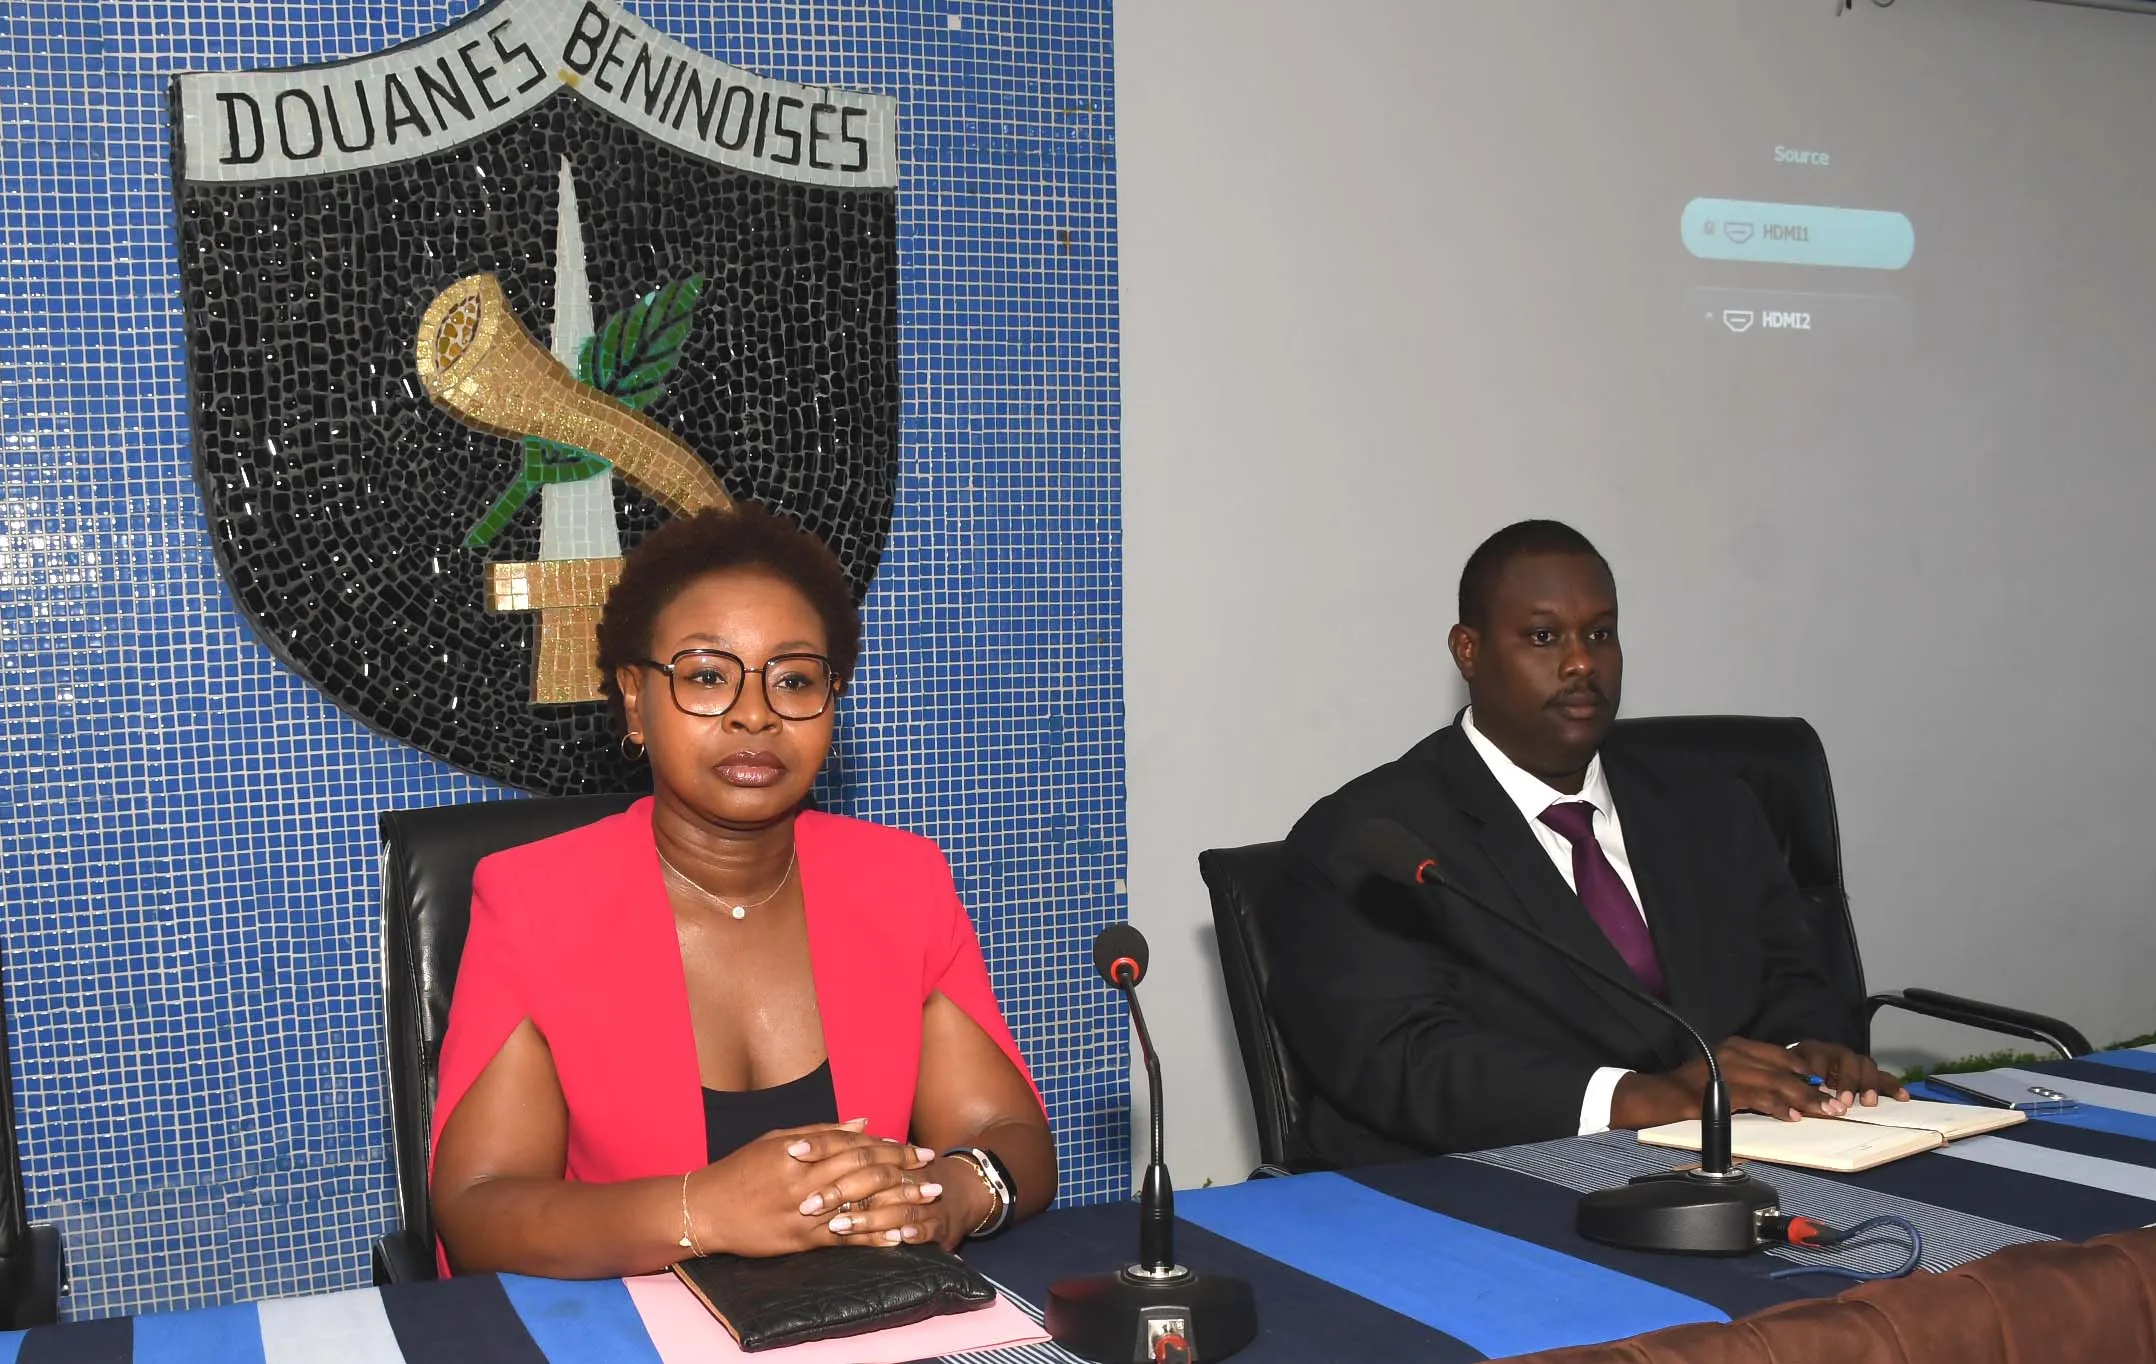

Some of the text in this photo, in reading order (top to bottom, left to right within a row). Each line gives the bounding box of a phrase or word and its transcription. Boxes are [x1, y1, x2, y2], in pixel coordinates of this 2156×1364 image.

[216, 0, 868, 172] DOUANES BENINOISES
[1773, 145, 1830, 166] Source
[1762, 223, 1810, 242] HDMI1
[1762, 310, 1811, 330] HDMI2
